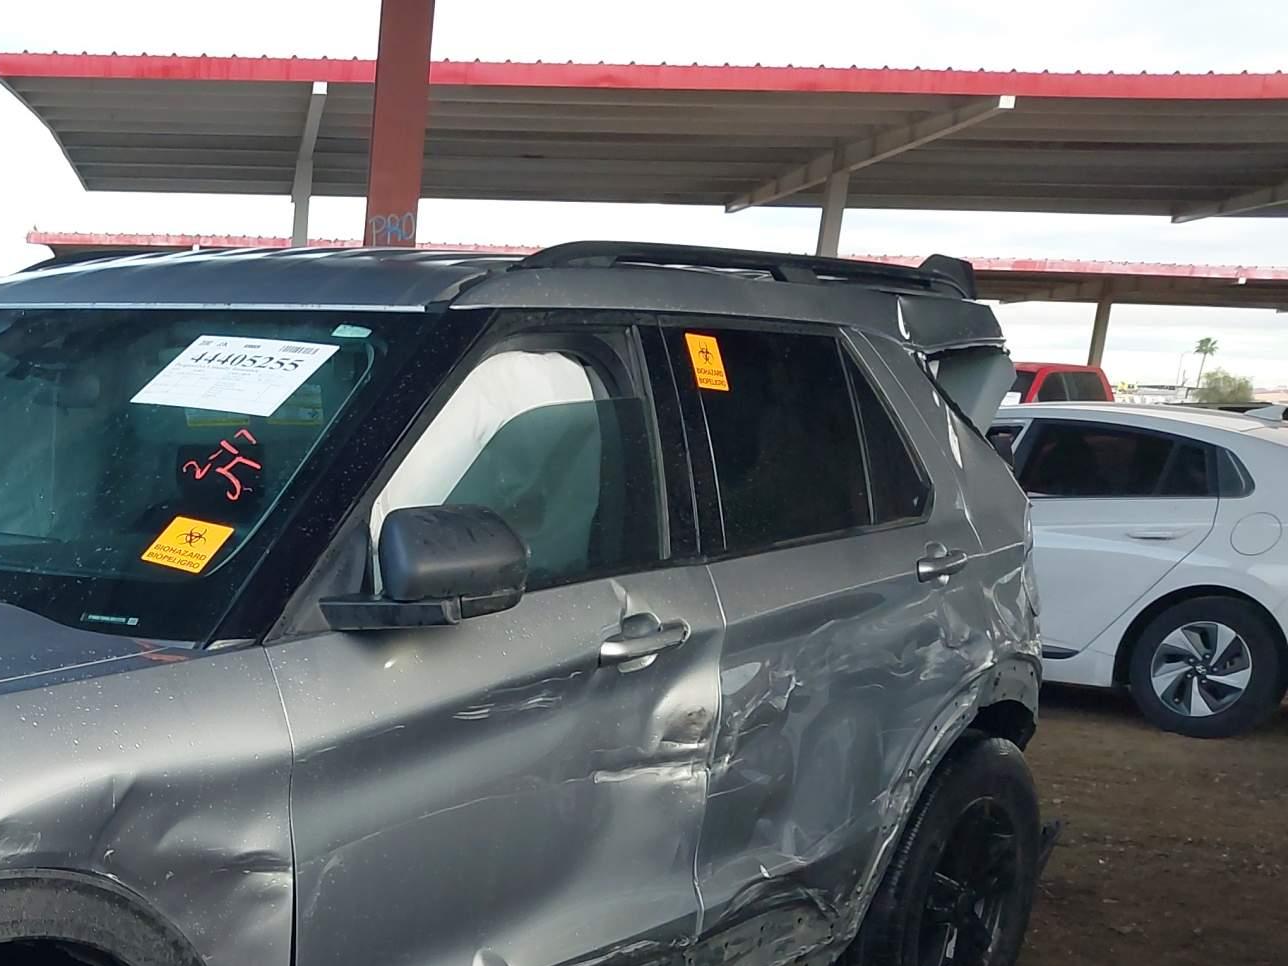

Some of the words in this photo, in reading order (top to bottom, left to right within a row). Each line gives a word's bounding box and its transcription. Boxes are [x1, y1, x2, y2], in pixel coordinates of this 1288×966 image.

[191, 351, 305, 372] 44405255
[146, 551, 201, 570] BIOPELIGRO
[153, 543, 208, 562] BIOHAZARD
